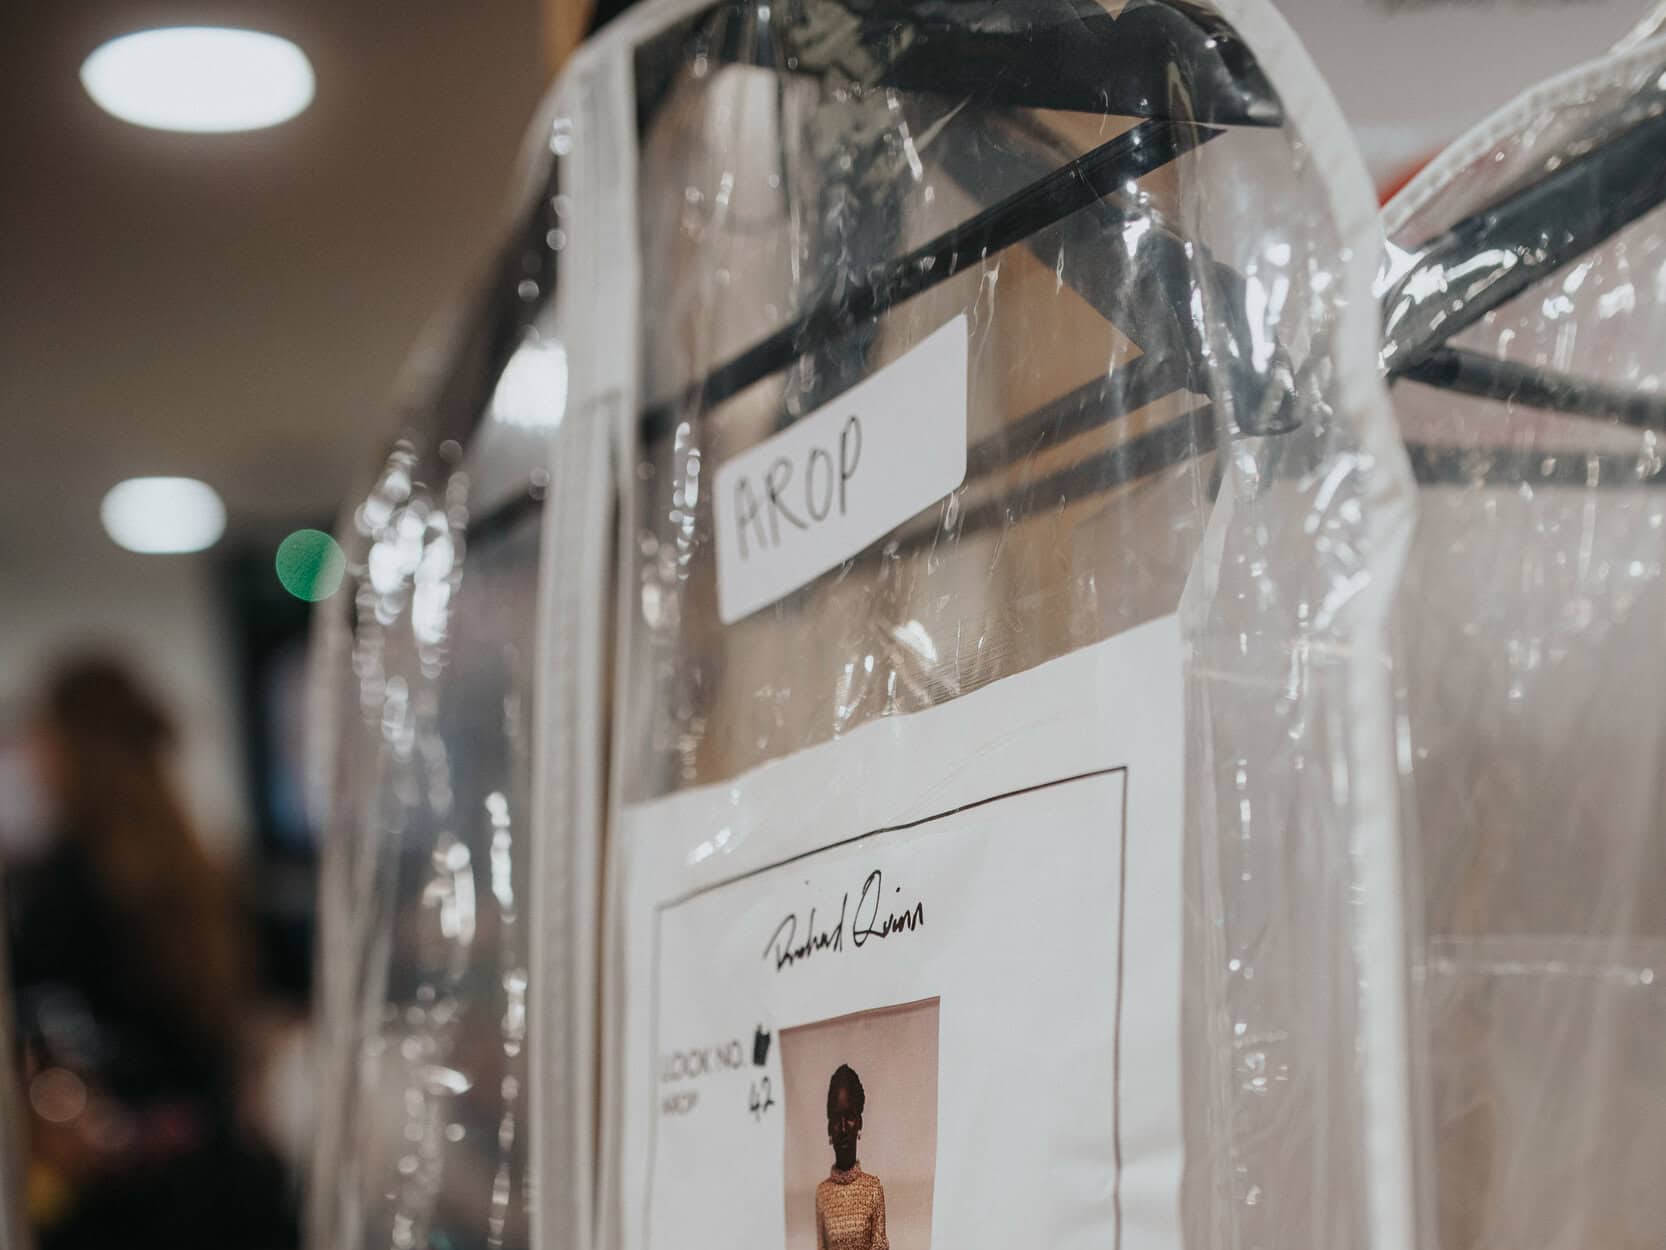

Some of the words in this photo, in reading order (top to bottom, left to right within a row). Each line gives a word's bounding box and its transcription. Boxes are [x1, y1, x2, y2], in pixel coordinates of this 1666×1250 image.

[733, 416, 862, 561] AROP
[853, 869, 924, 948] Quinn
[748, 1074, 777, 1123] 42
